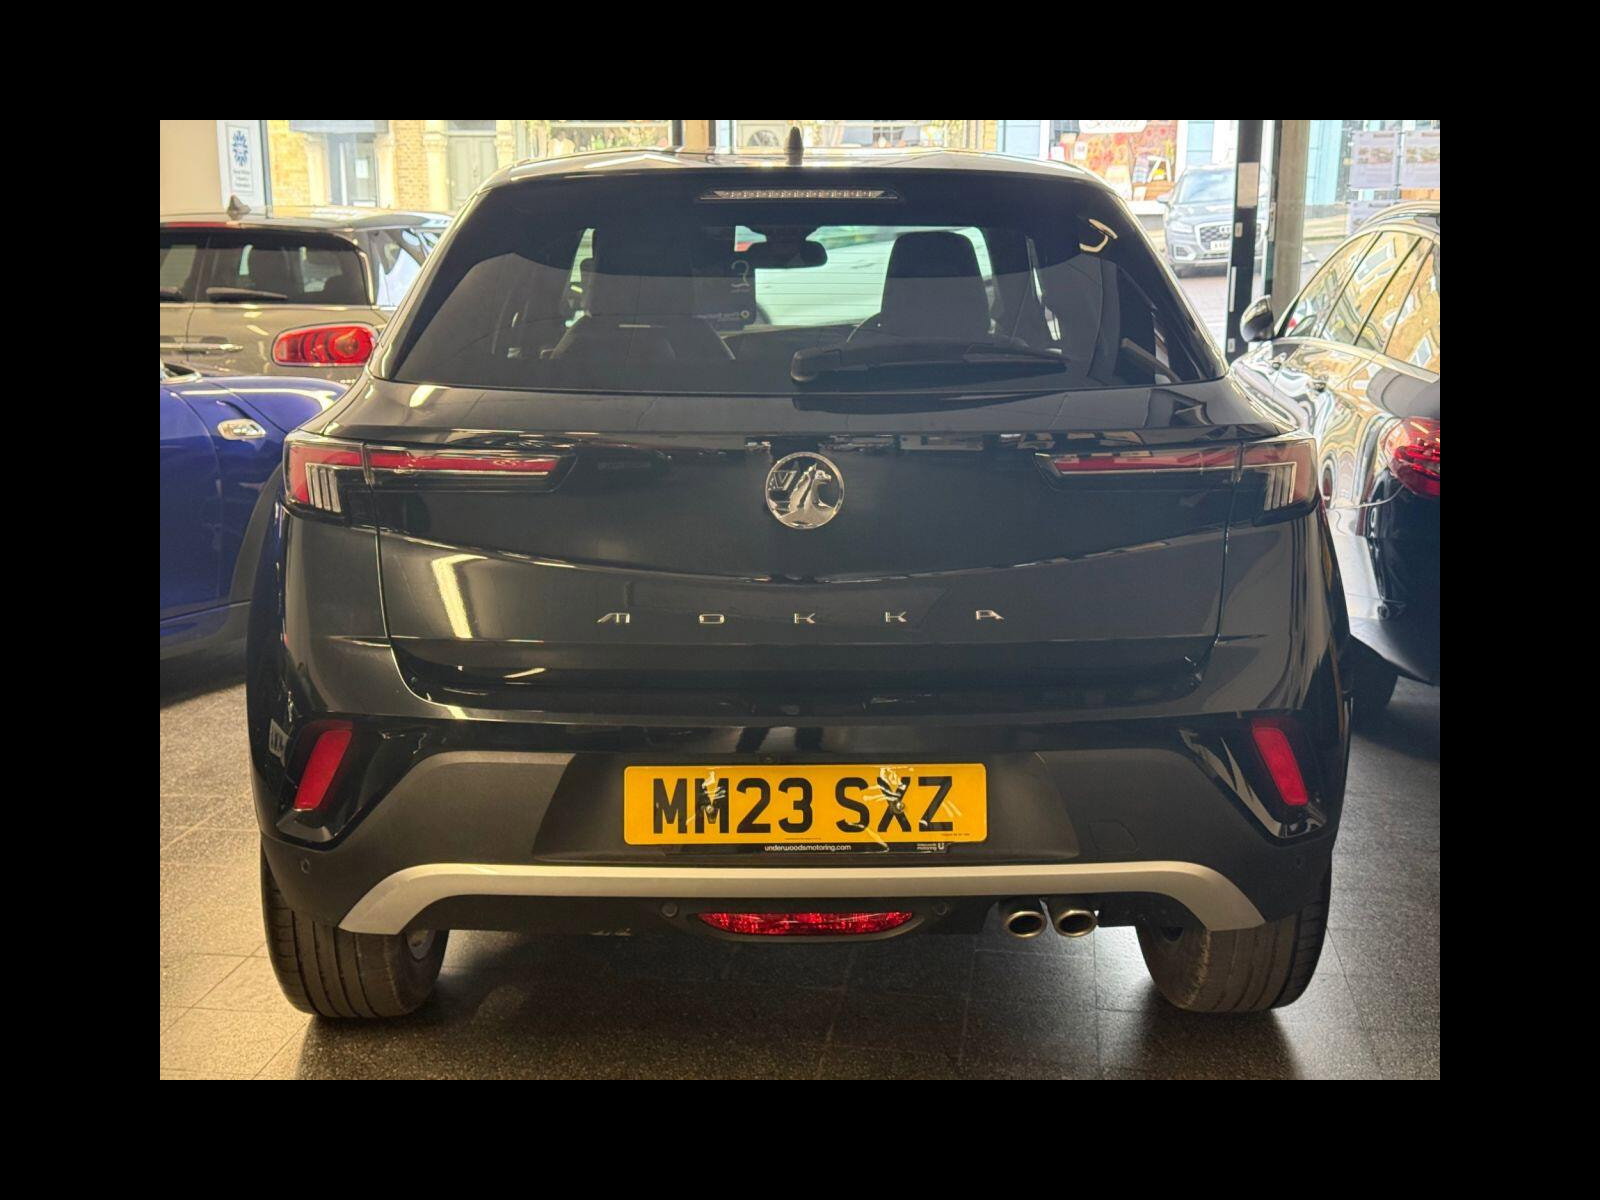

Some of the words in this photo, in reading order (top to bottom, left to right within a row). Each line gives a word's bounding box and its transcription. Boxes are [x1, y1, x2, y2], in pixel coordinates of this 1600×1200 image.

[598, 609, 1003, 624] MOKKA
[653, 778, 813, 834] MM23
[835, 776, 953, 833] SXZ
[765, 843, 852, 852] underwoodsmotoring.com
